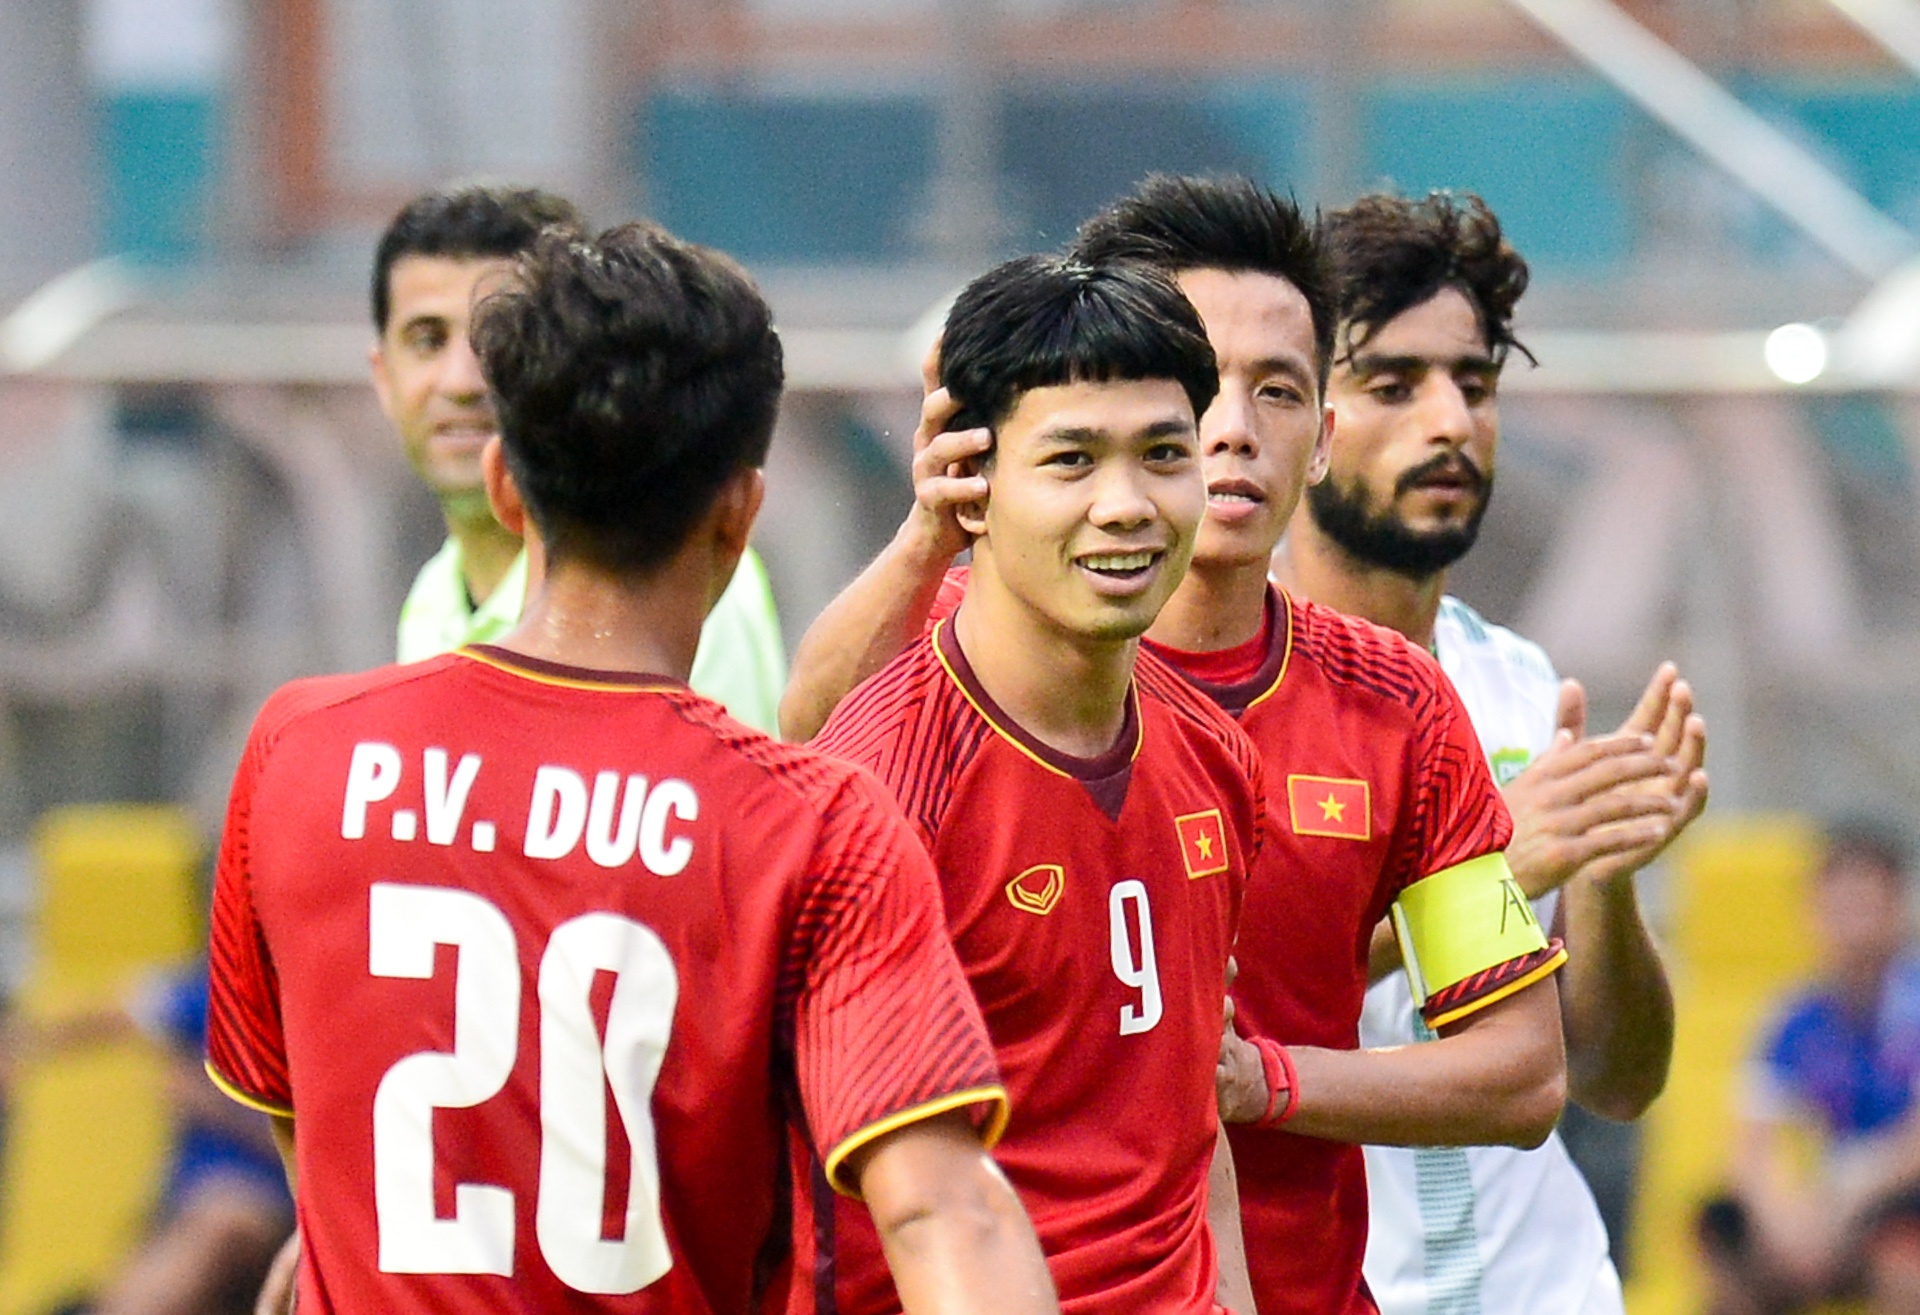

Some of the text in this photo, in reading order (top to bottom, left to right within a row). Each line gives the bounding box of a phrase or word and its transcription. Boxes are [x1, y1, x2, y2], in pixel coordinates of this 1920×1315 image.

[341, 741, 699, 877] P.V. DUC
[1109, 879, 1163, 1035] 9
[368, 882, 680, 1295] 20
